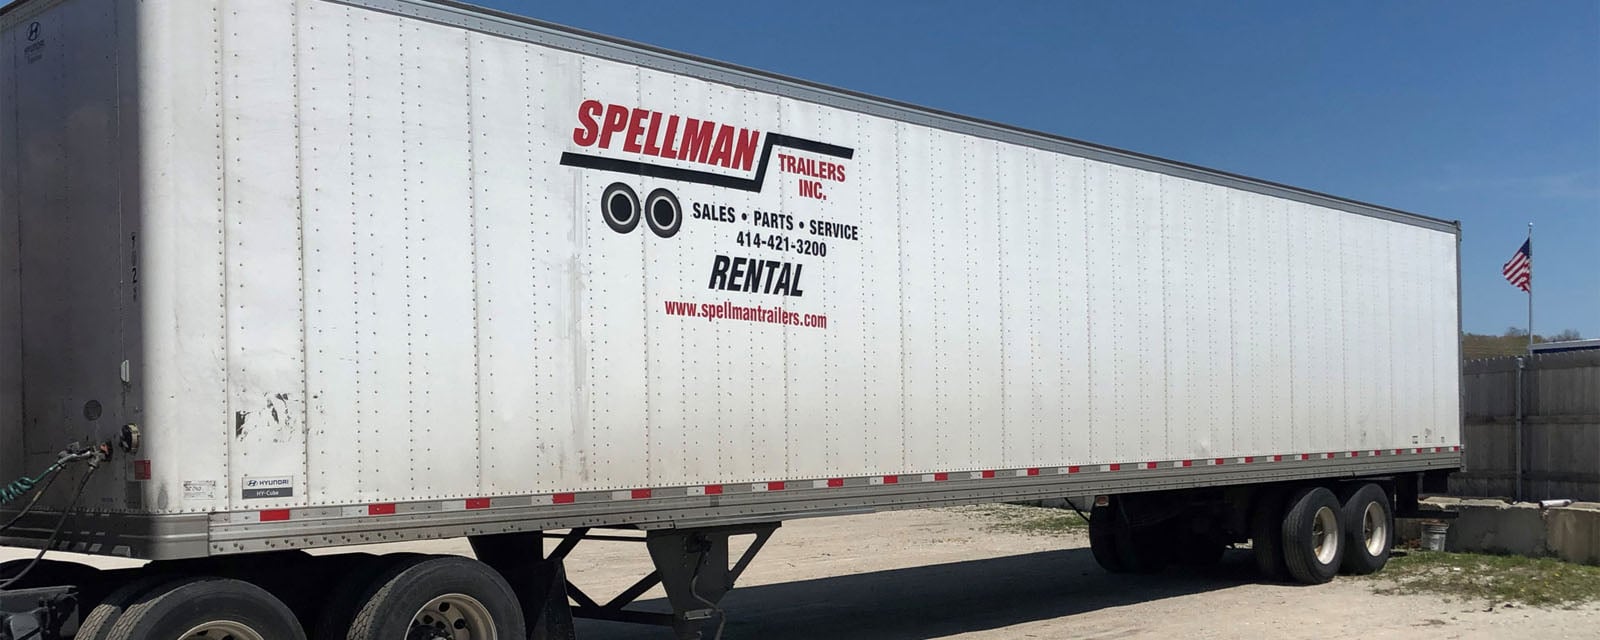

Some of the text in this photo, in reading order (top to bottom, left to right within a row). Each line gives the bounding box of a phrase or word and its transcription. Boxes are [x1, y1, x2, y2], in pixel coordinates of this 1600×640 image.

[573, 99, 760, 171] SPELLMAN
[778, 153, 846, 183] TRAILERS
[798, 179, 827, 200] INC.
[692, 202, 859, 240] SALES PARTS SERVICE
[736, 231, 828, 257] 414-421-3200
[708, 254, 804, 297] RENTAL
[665, 301, 827, 329] www.spellmantrailers.com
[256, 489, 280, 497] HY-Cube
